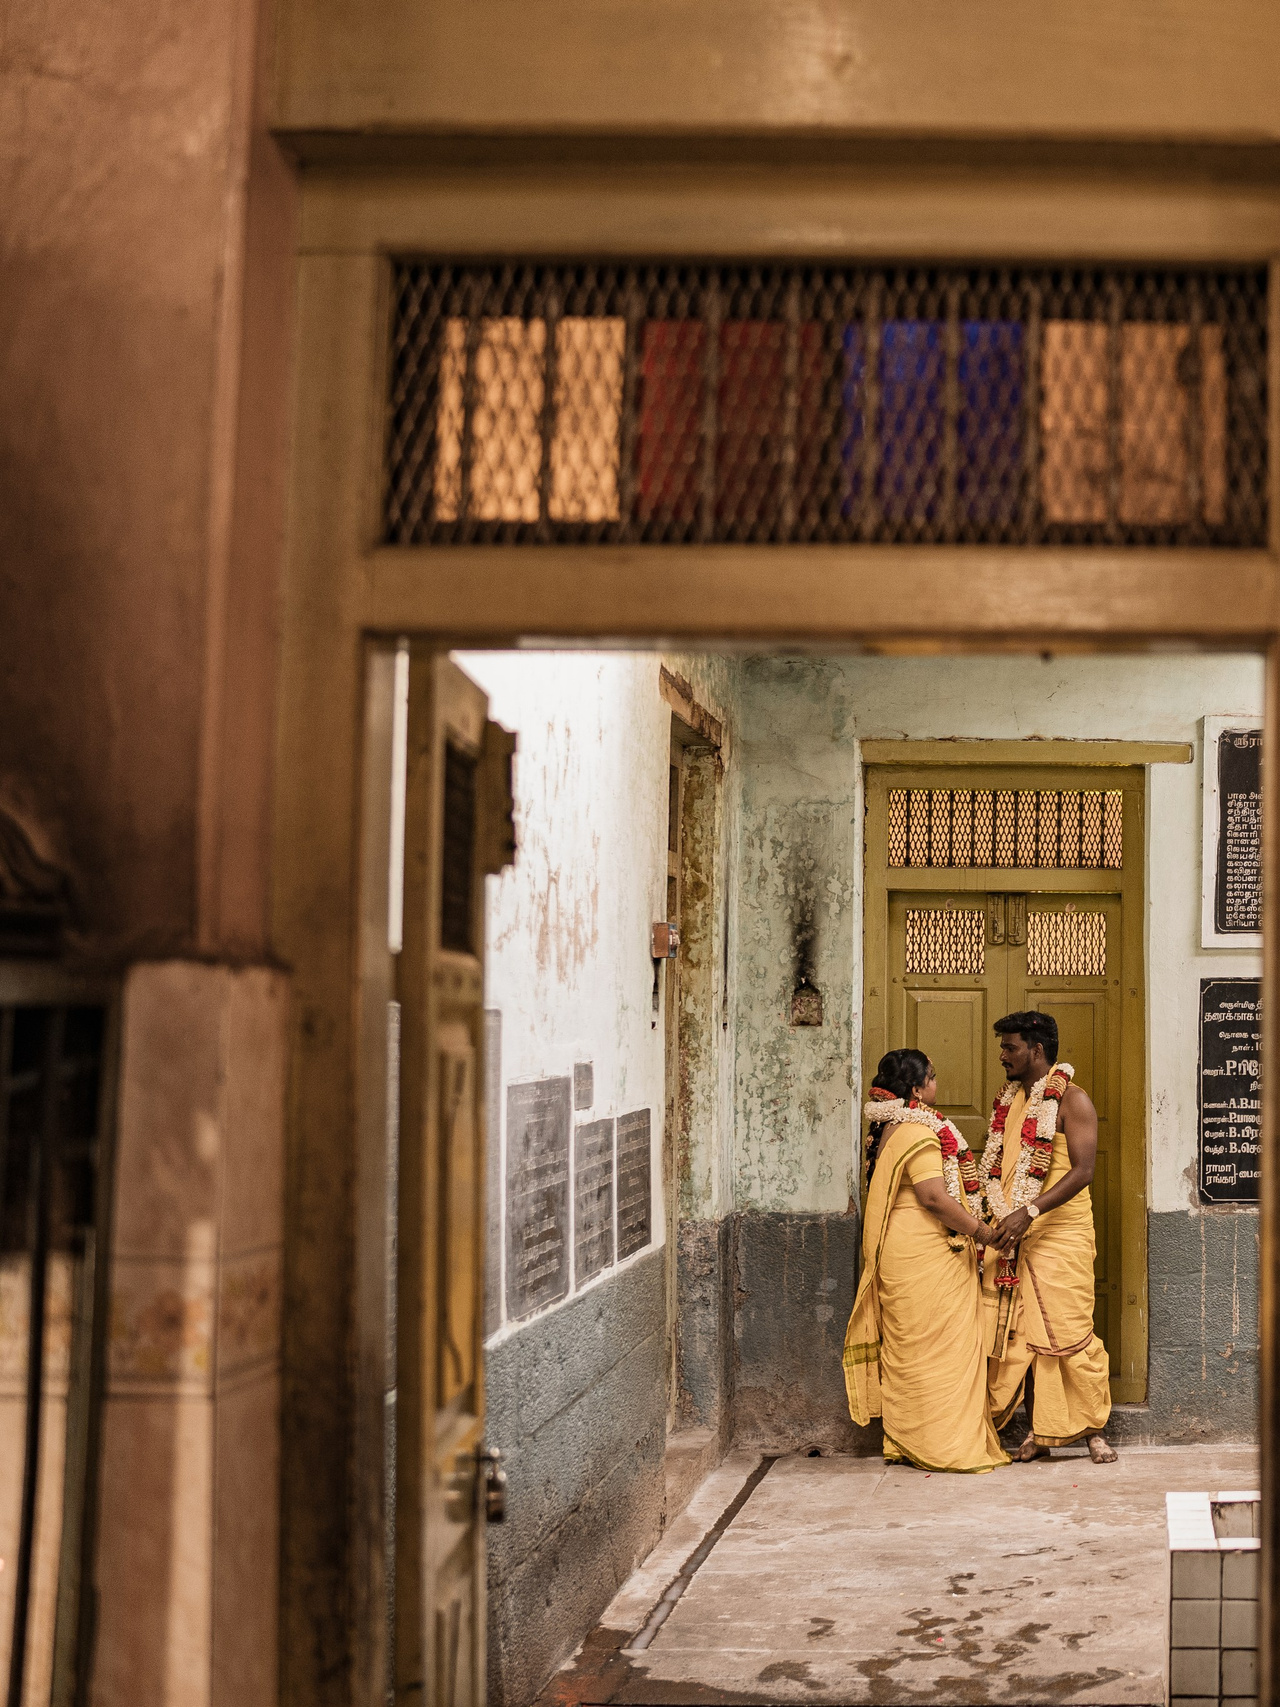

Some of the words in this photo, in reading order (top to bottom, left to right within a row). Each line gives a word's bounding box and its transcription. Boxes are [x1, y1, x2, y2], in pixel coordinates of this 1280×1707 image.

[1227, 799, 1256, 808] சித்ரா
[1227, 867, 1258, 876] கவிதா
[1226, 919, 1255, 927] பிரியா
[1219, 1001, 1256, 1010] அருள்மிகு
[1204, 1010, 1254, 1023] தரைக்காக
[1218, 1031, 1249, 1040] தொகை
[1205, 1164, 1232, 1175] ராமா
[1205, 1173, 1234, 1186] ரங்கா
